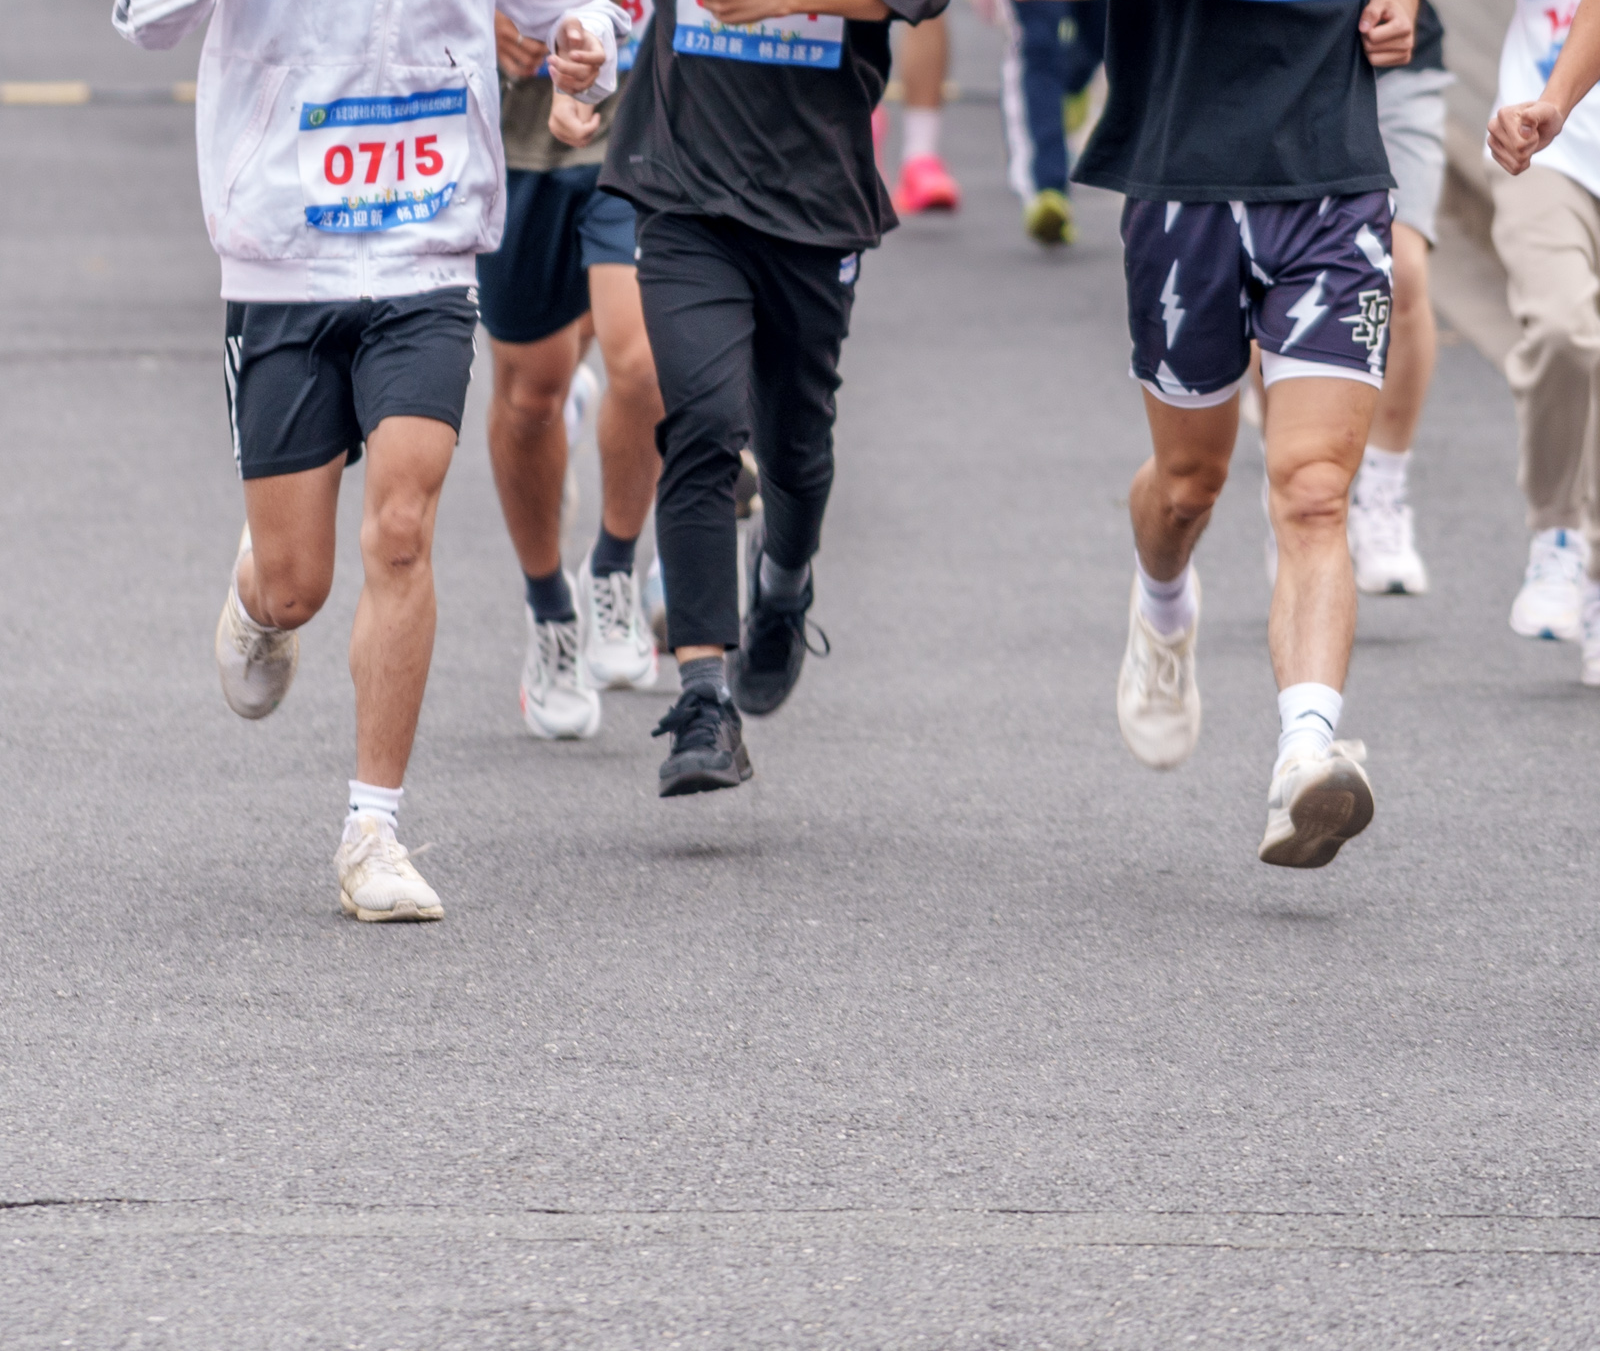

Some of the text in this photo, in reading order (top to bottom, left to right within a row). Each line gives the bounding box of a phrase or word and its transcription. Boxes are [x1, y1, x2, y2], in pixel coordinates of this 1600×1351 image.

[324, 134, 444, 185] 0715
[320, 208, 383, 227] 活力迎新
